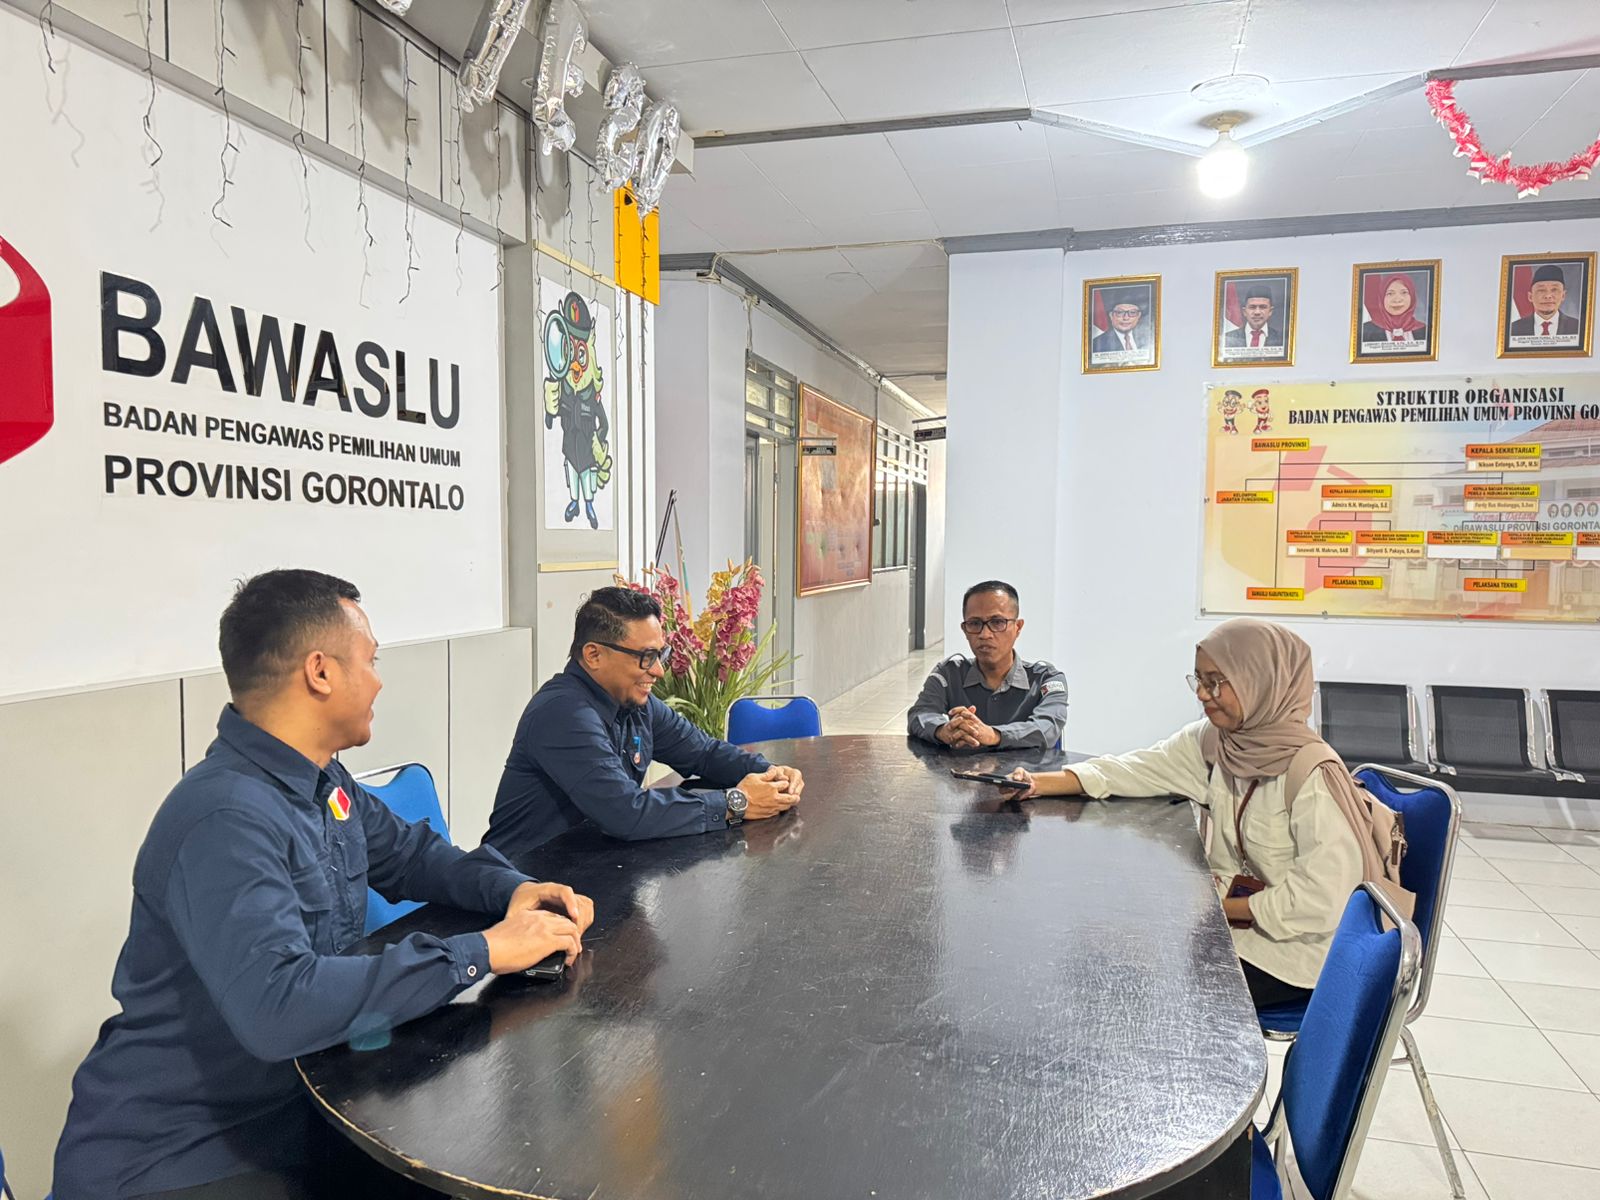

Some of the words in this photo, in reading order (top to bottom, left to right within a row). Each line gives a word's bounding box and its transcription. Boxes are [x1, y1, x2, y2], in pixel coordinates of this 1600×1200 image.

[99, 269, 461, 430] BAWASLU
[1376, 389, 1460, 406] STRUKTUR
[1465, 387, 1565, 404] ORGANISASI
[1288, 409, 1329, 425] BADAN
[1333, 408, 1397, 424] PENGAWAS
[1401, 406, 1470, 423] PEMILIHAN
[1473, 406, 1510, 422] UMUM
[1514, 404, 1577, 421] PROVINSI
[103, 401, 198, 438] BADAN
[205, 416, 325, 452] PENGAWAS
[328, 433, 417, 464] PEMILIHAN
[419, 443, 461, 468] UMUM
[1495, 446, 1536, 454] SEKRETARIAT
[104, 454, 292, 502] PROVINSI
[301, 470, 465, 512] GORONTALO
[1507, 522, 1550, 531] PROVINSI
